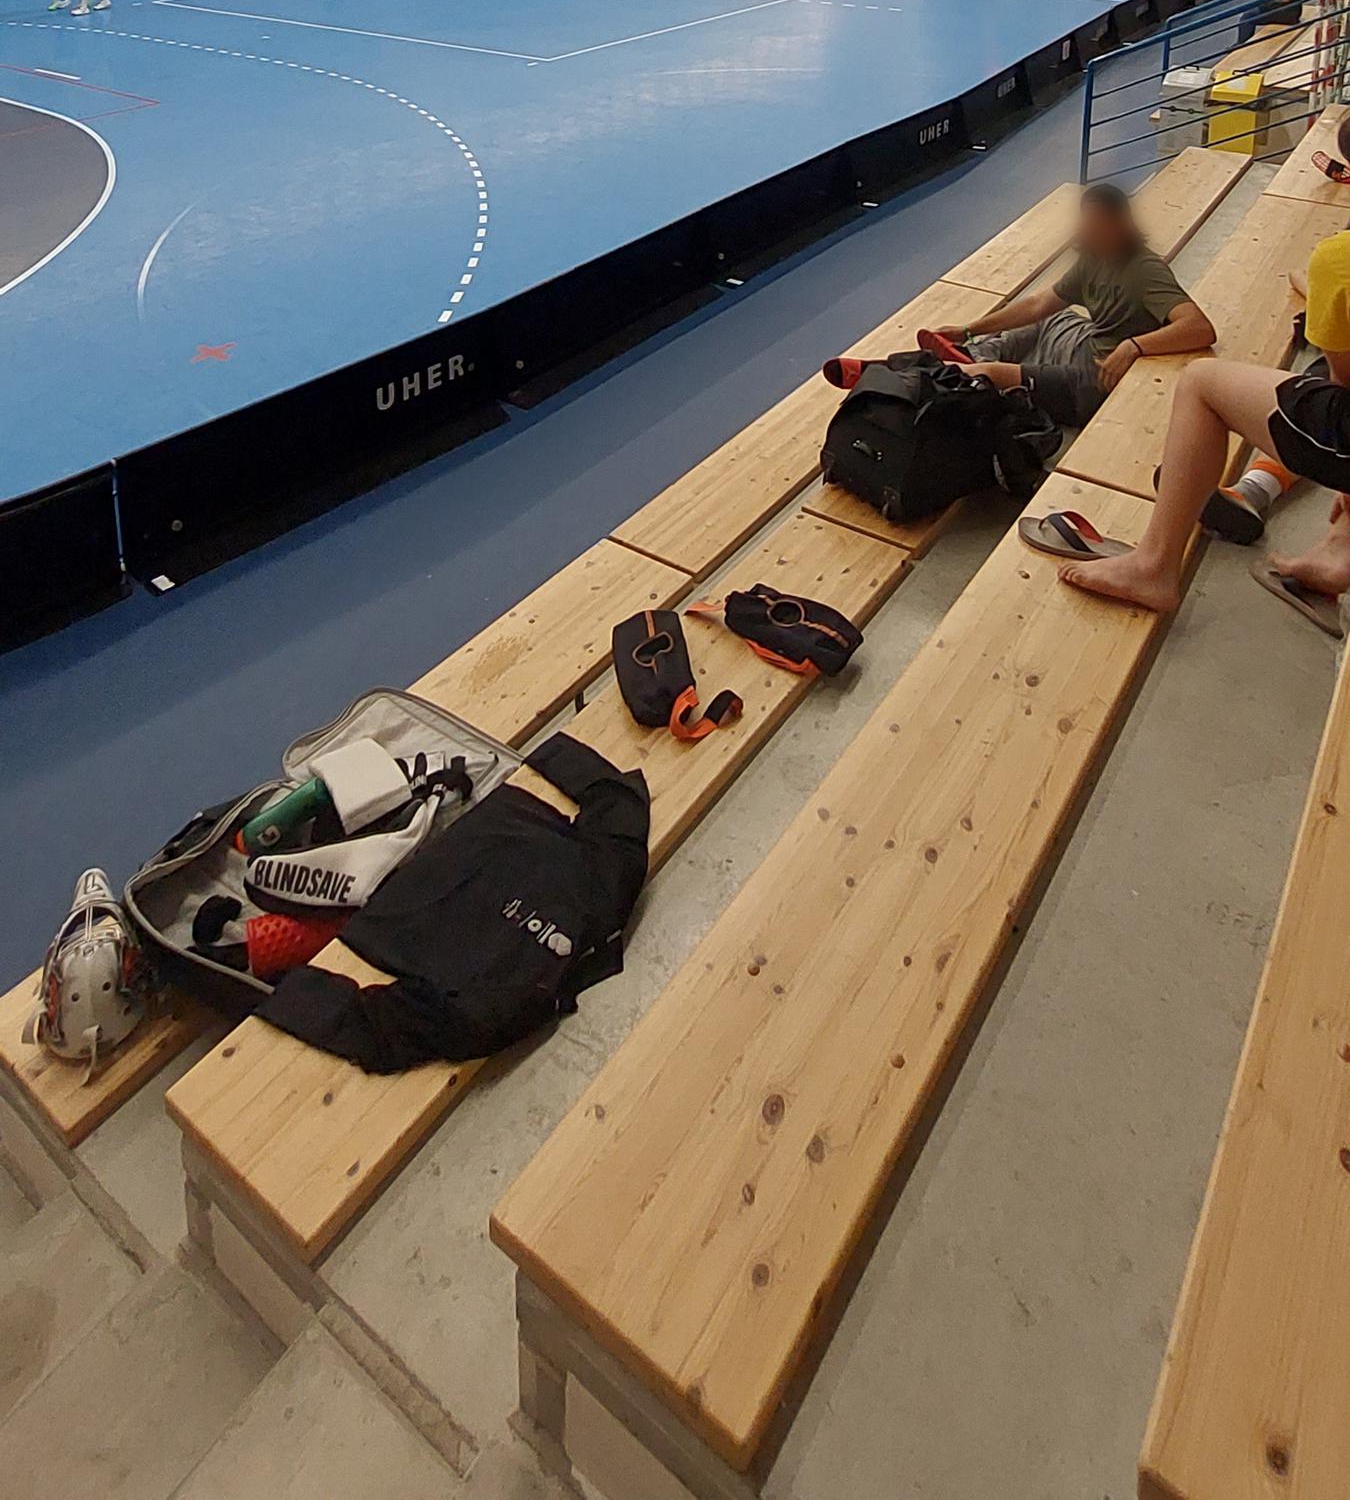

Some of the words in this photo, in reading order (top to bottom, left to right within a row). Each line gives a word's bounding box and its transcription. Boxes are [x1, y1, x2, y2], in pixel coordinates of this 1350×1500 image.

[919, 119, 950, 145] UHER
[376, 354, 465, 411] UHER
[253, 859, 356, 904] BLINDSAVE
